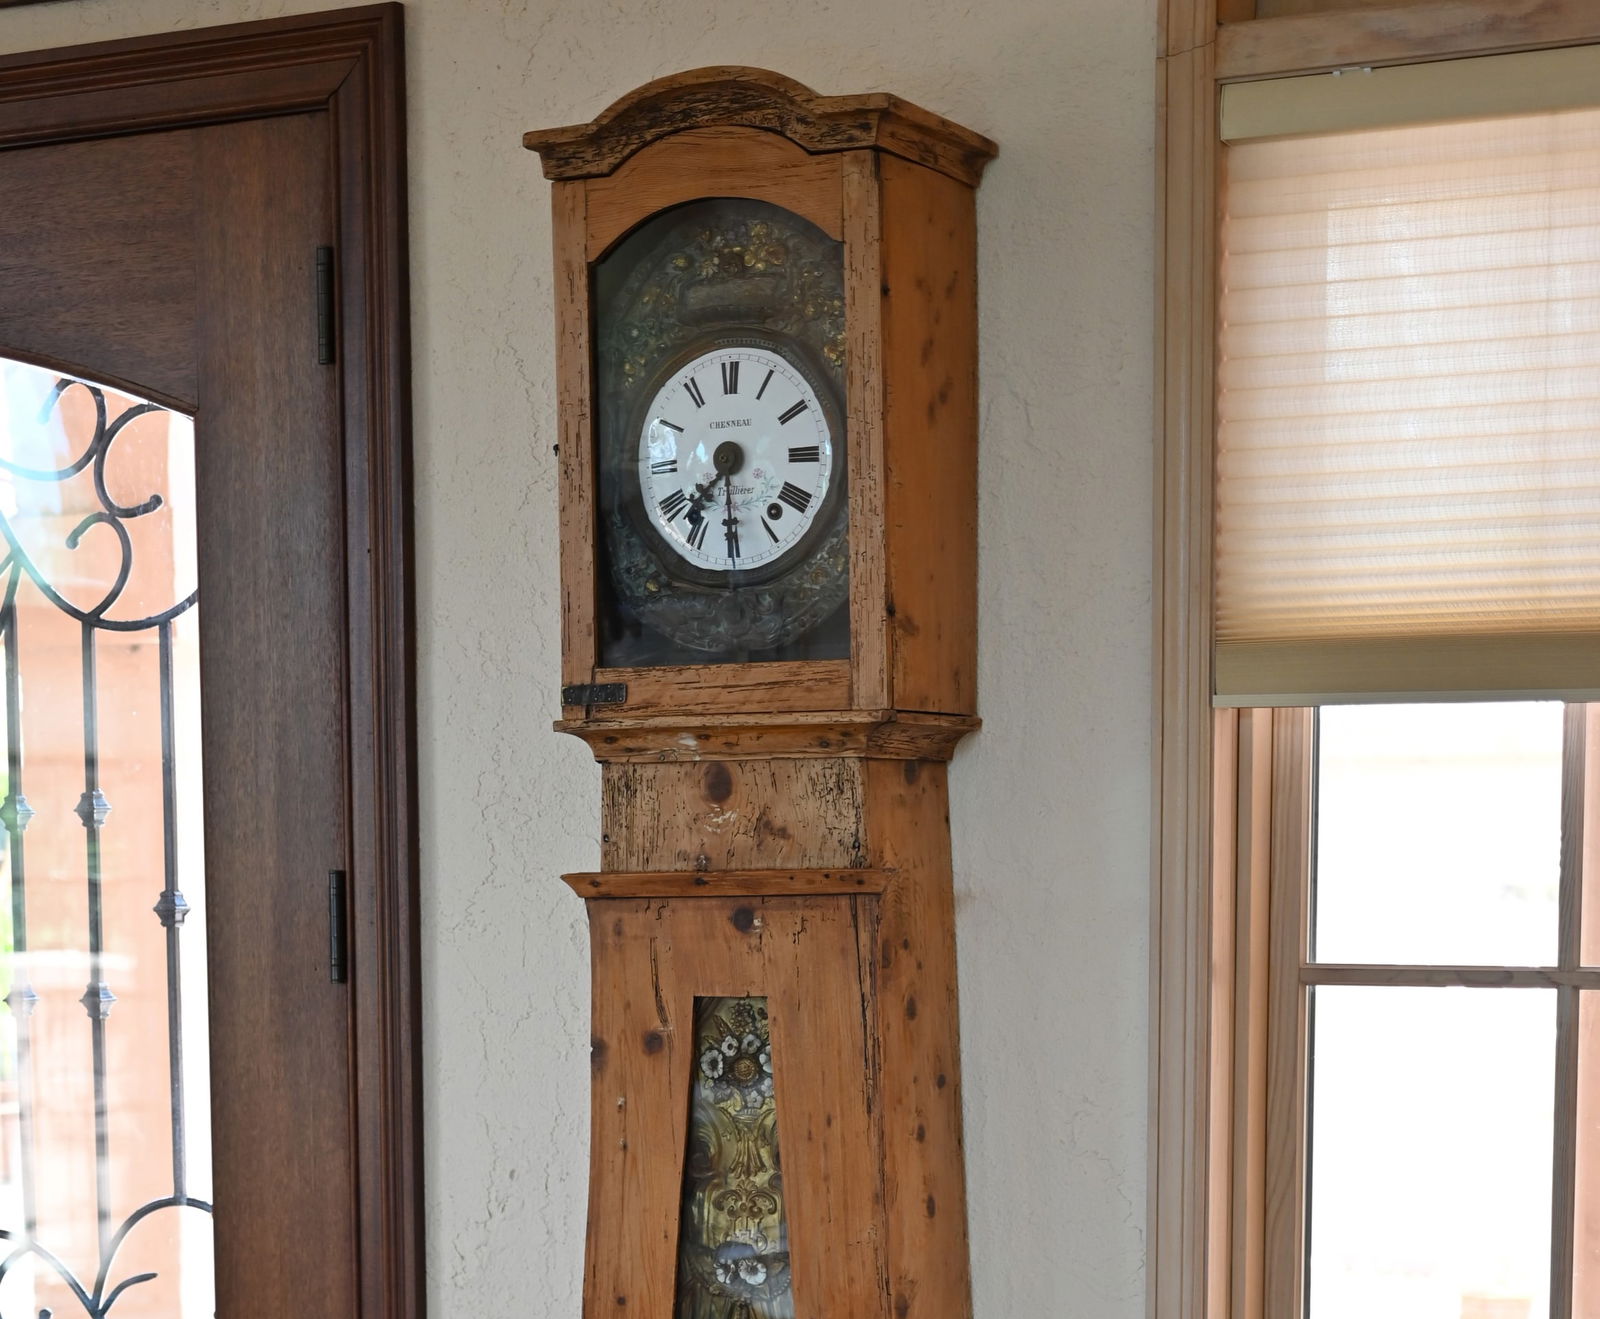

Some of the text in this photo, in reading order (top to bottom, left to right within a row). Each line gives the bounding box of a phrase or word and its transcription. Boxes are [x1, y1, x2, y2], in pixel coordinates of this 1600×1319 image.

[756, 369, 775, 400] I
[709, 418, 752, 430] CHESNEAU
[777, 399, 809, 426] II
[788, 445, 820, 463] III
[777, 481, 813, 514] IIII
